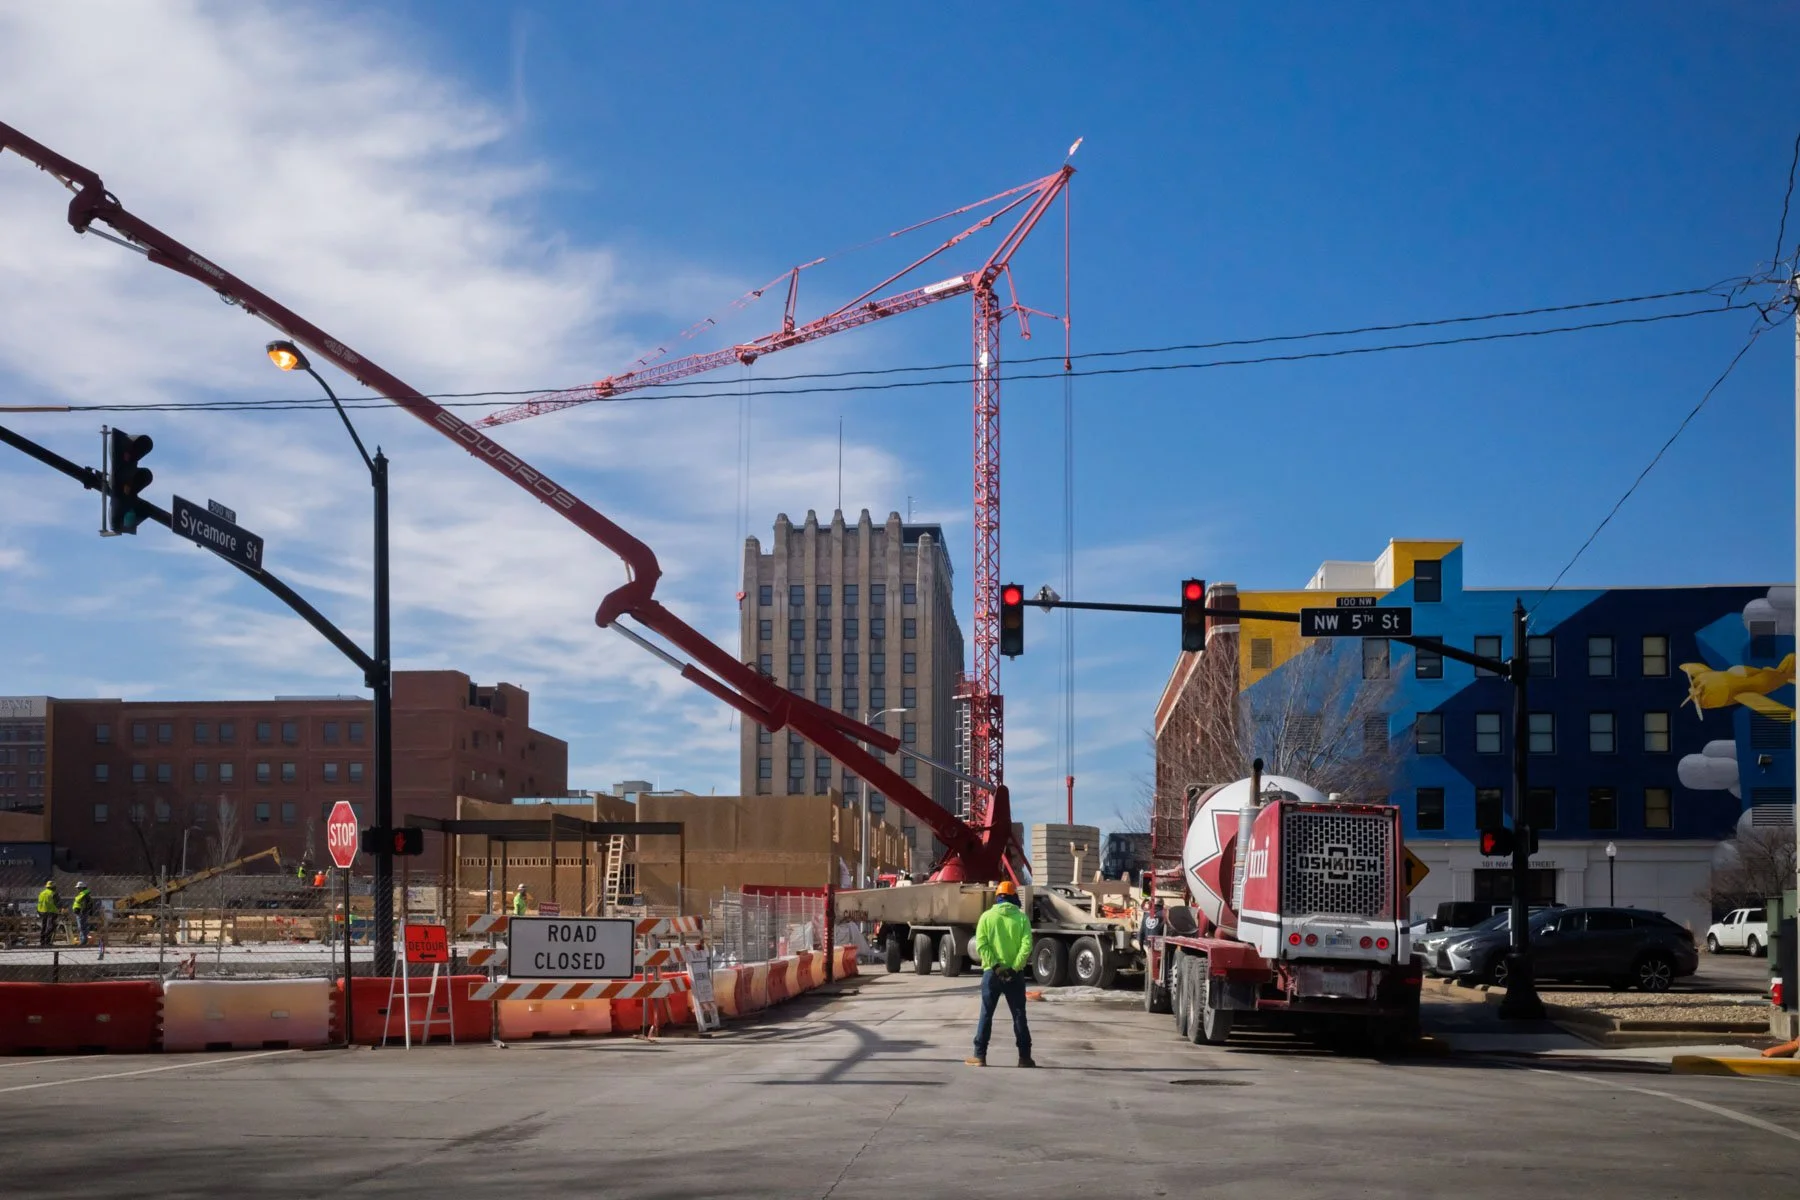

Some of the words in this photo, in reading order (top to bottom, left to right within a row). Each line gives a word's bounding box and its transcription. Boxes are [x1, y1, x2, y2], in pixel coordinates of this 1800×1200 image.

[434, 411, 576, 509] EDWARDS
[180, 508, 237, 552] Sycamore
[246, 540, 258, 562] St
[1340, 598, 1356, 606] 100
[1359, 598, 1373, 606] NW
[1314, 615, 1339, 630] NW
[1352, 614, 1374, 630] 5TH
[1382, 613, 1400, 630] St
[330, 822, 355, 847] STOP
[1298, 856, 1378, 873] OSHKOSH
[1482, 860, 1494, 868] 101
[1495, 860, 1509, 868] NW
[1528, 860, 1557, 868] STREET
[843, 909, 869, 921] CAUTION
[548, 924, 597, 942] ROAD
[408, 941, 445, 952] DETOUR
[534, 952, 605, 970] CLOSED
